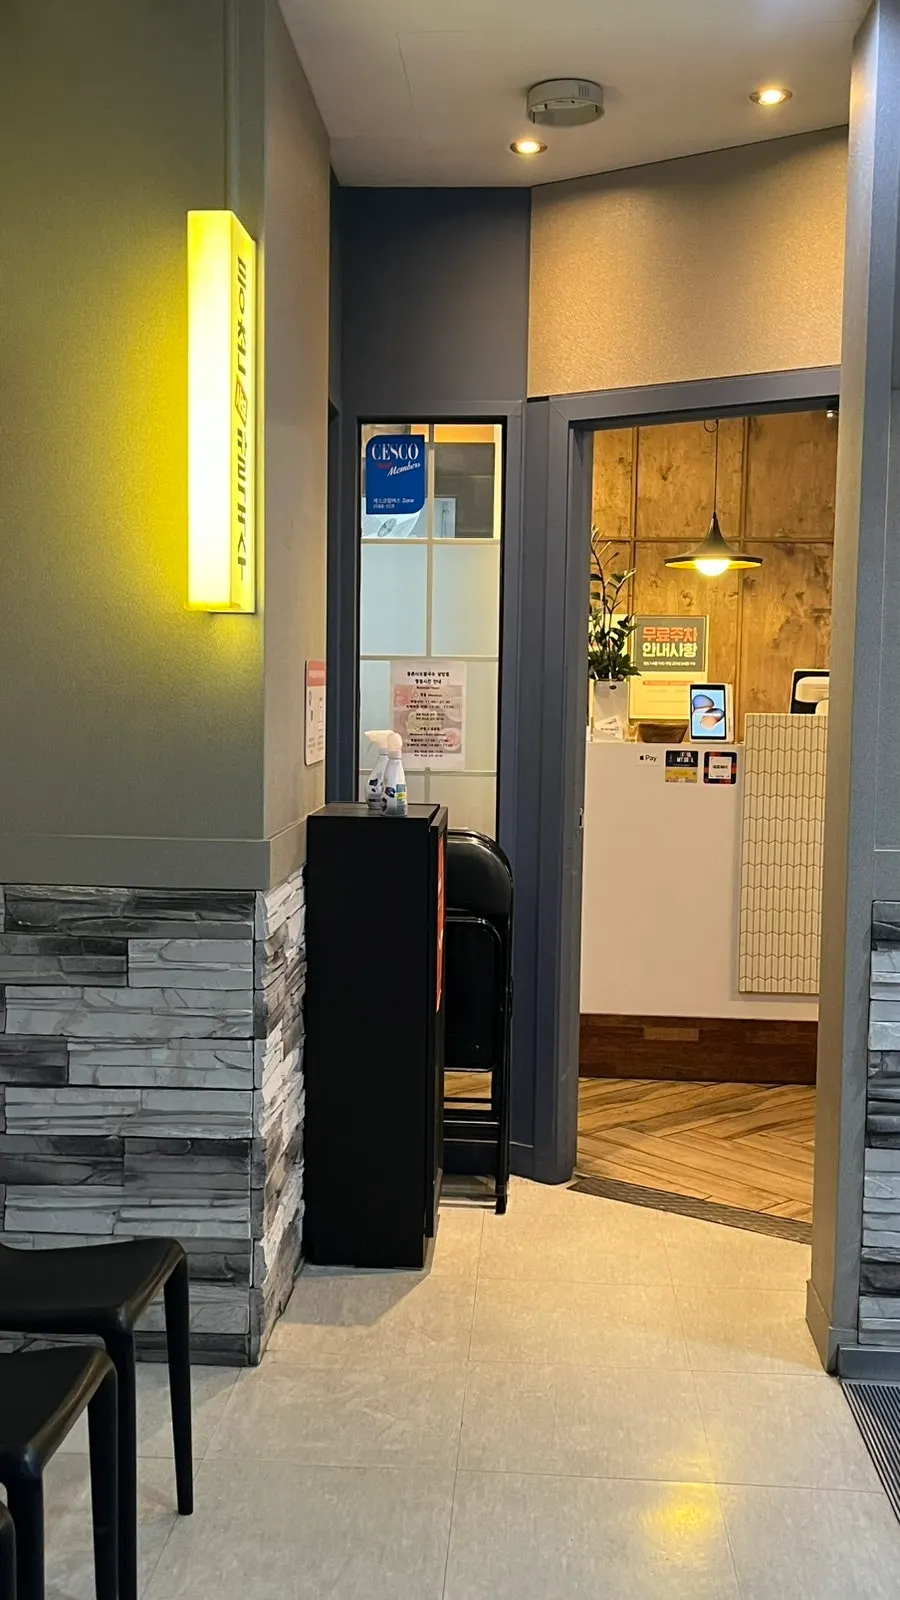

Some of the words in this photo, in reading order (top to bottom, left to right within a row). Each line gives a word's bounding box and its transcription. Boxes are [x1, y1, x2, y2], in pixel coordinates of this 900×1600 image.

[371, 443, 419, 460] CESCO
[387, 461, 421, 477] Members
[643, 627, 698, 642] 무료주차
[642, 643, 698, 658] 안내사항
[645, 754, 657, 763] Pay
